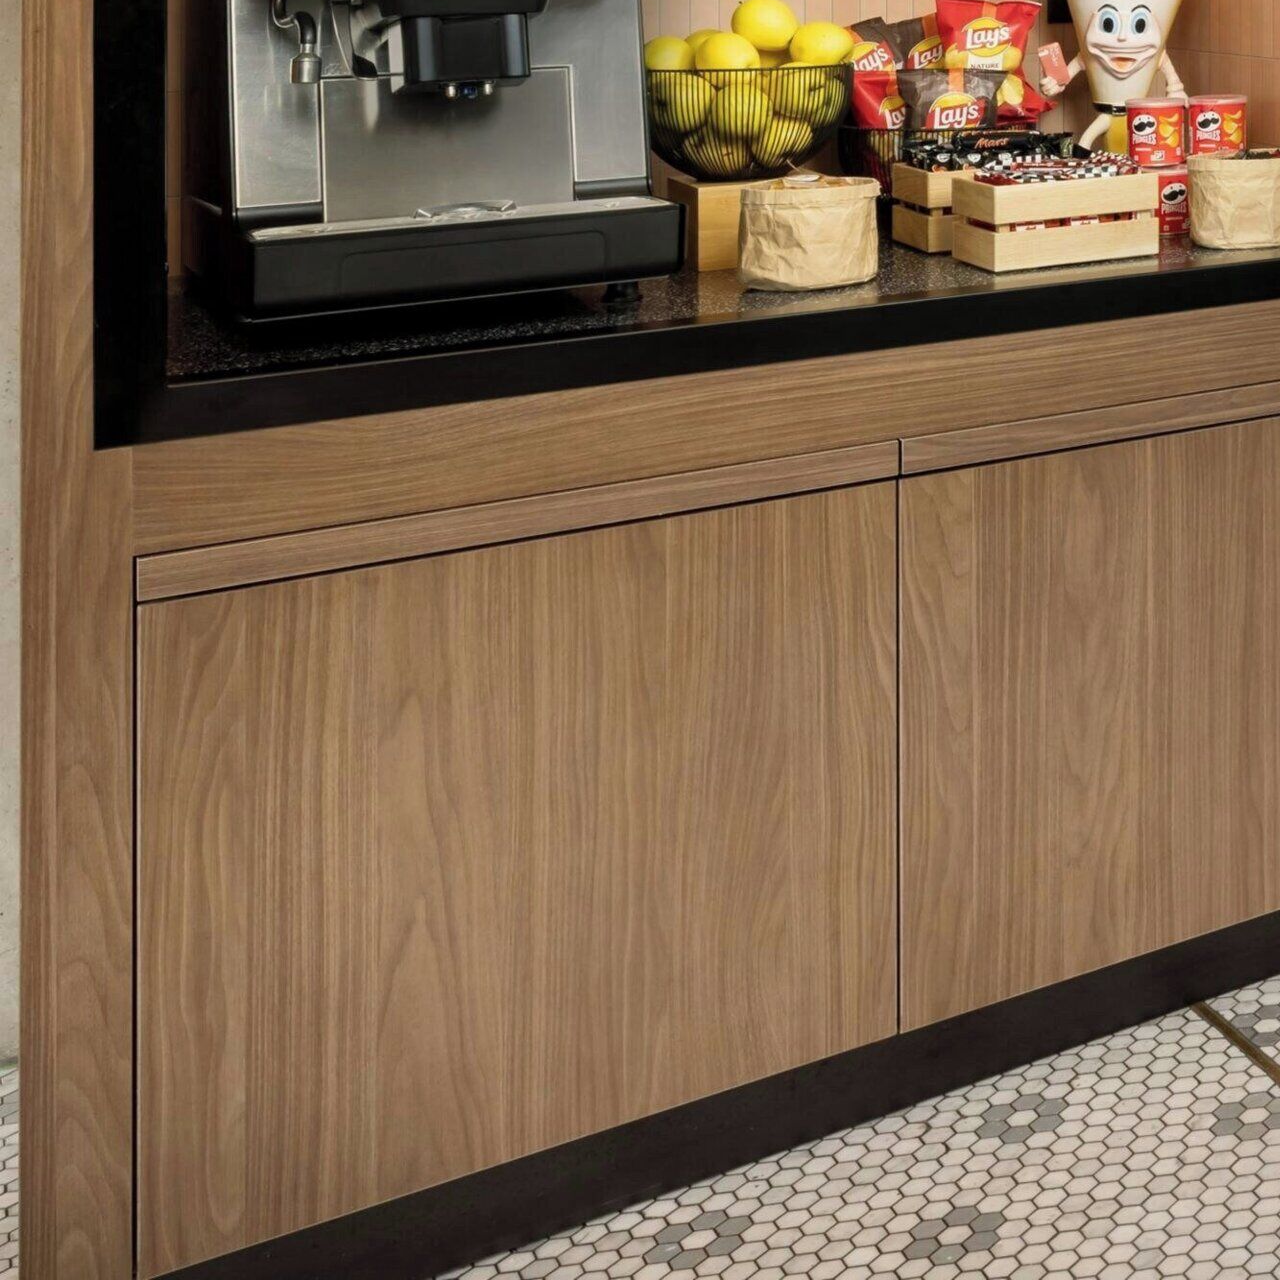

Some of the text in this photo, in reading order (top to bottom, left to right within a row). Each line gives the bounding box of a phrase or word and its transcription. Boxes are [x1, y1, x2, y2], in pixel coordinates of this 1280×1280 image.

[965, 25, 1011, 49] Lay's
[914, 45, 943, 69] Lay
[934, 103, 980, 130] Lay's
[974, 137, 1008, 149] Mars
